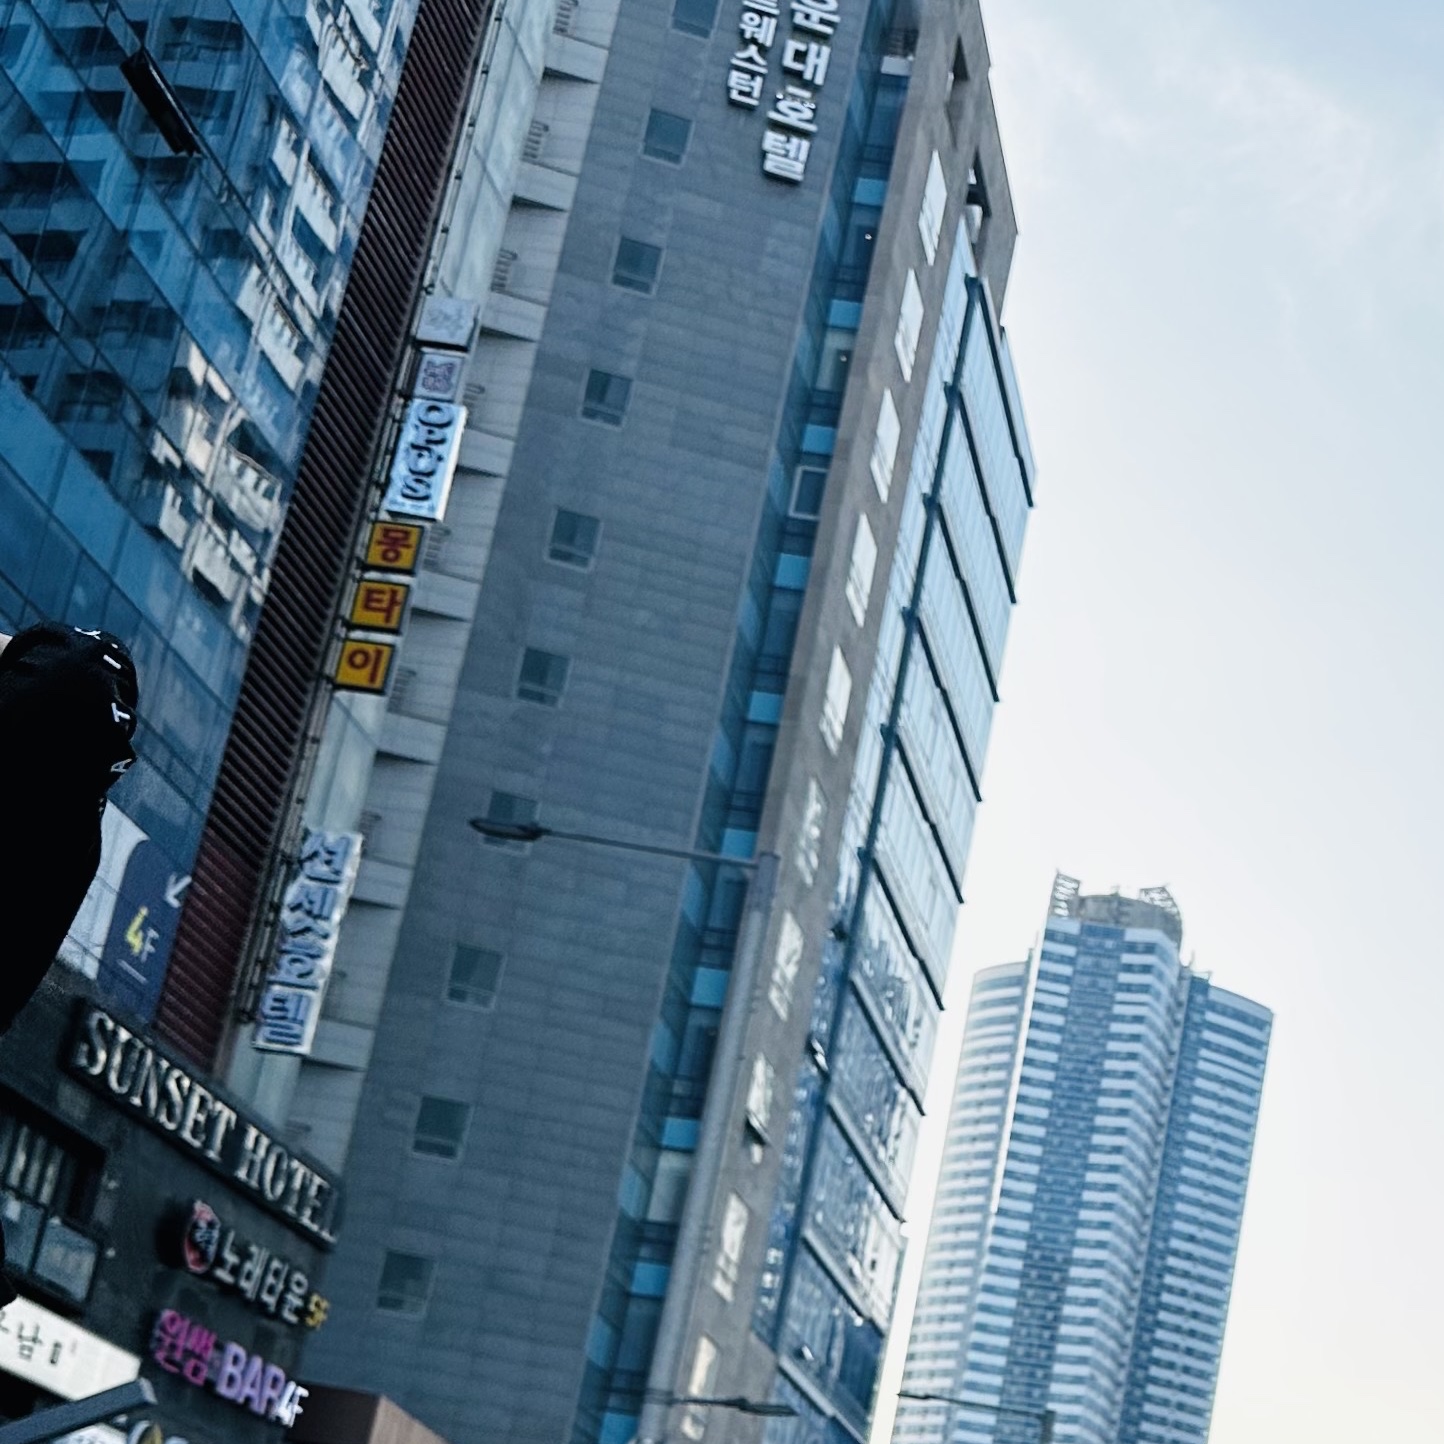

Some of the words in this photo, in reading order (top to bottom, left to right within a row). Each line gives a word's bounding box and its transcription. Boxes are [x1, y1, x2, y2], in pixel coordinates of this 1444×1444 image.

[79, 1009, 237, 1163] SUNSET
[235, 1122, 338, 1243] HOTEL
[215, 1341, 287, 1416] BAR
